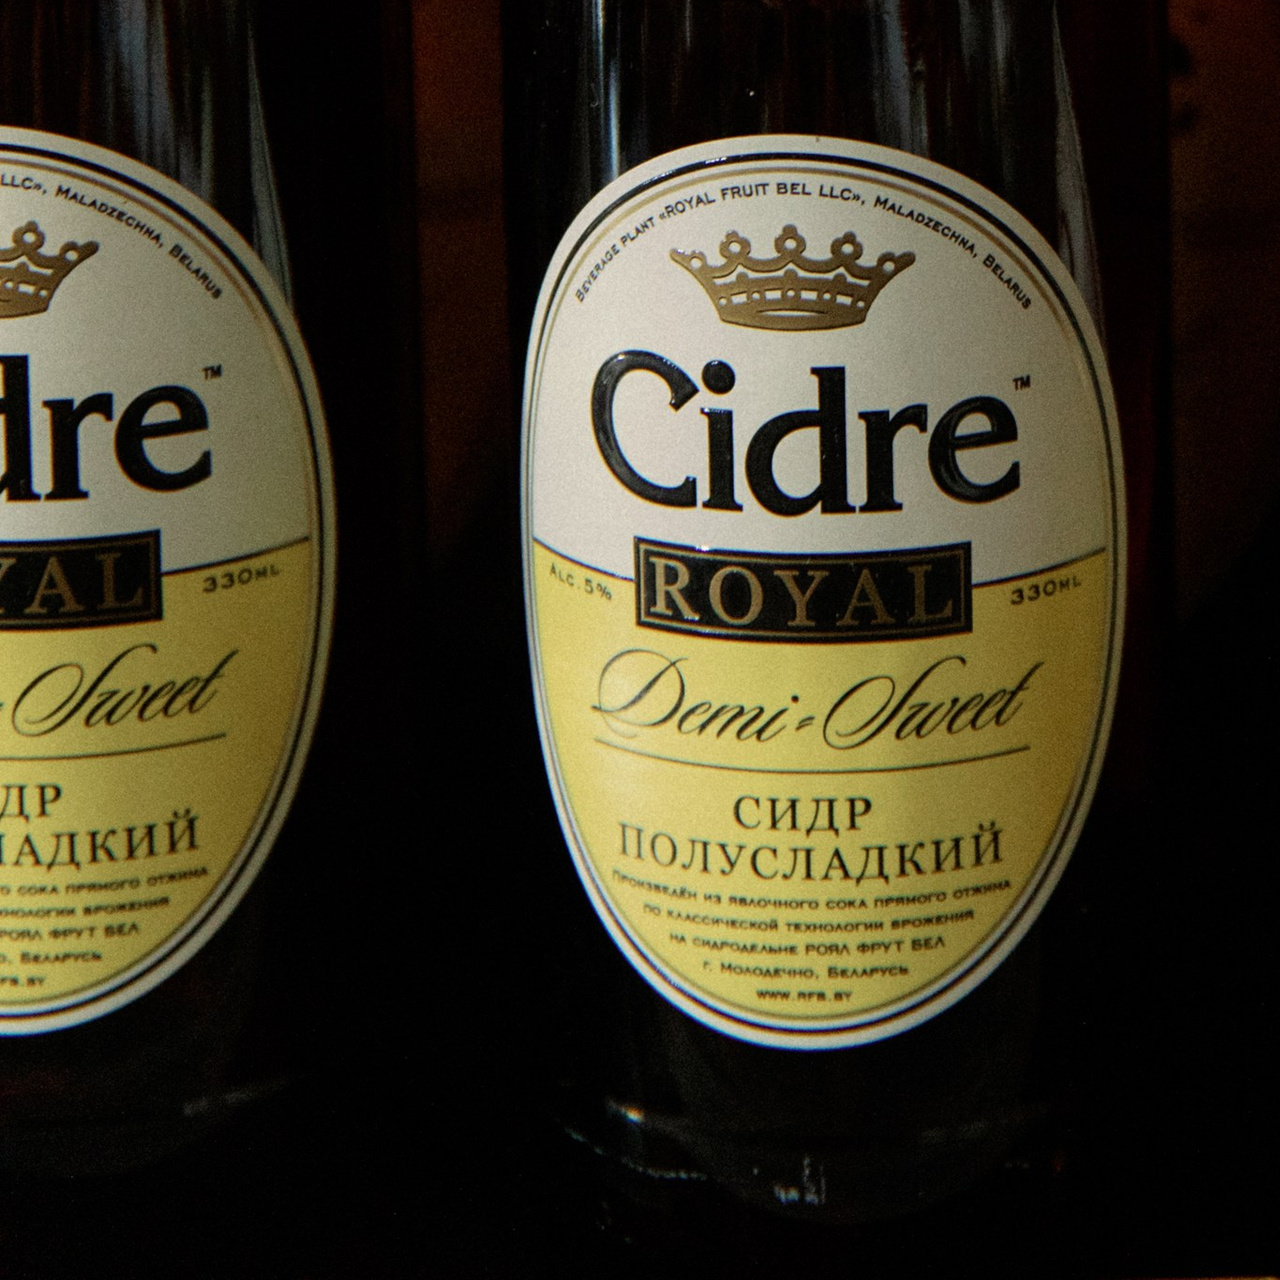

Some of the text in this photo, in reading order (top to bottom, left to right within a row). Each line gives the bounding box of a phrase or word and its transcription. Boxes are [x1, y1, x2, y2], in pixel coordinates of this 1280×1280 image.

[169, 243, 223, 300] BELARUS
[575, 243, 621, 303] BEVERAGE
[620, 216, 656, 248] PLANT
[720, 182, 770, 202] FRUIT
[776, 182, 812, 196] BEL
[873, 195, 978, 259] MALADZECHNA,
[982, 252, 1033, 310] BELARUS
[591, 349, 1020, 518] Cidre
[584, 577, 613, 601] 5%
[648, 554, 955, 628] ROYAL
[0, 643, 239, 737] Sweet
[590, 647, 1045, 751] Demi-Sweet
[733, 795, 873, 837] СИДР
[617, 820, 1004, 886] ПОЛУСЛАДКИЙ
[643, 902, 975, 934] ПО КЛАССИЧЕСКОЙ ТЕХНОЛОГИИ БРОЖЕНИЯ
[704, 892, 722, 905] ИЗ
[825, 897, 868, 910] СОКА
[873, 891, 948, 909] ПРЯМОГО
[669, 932, 687, 945] НА
[804, 942, 851, 957] РОЯЛ
[856, 940, 905, 955] ФРУТ
[911, 936, 946, 953] БЕЛ
[827, 964, 909, 980] БЕЛАРУСЬ
